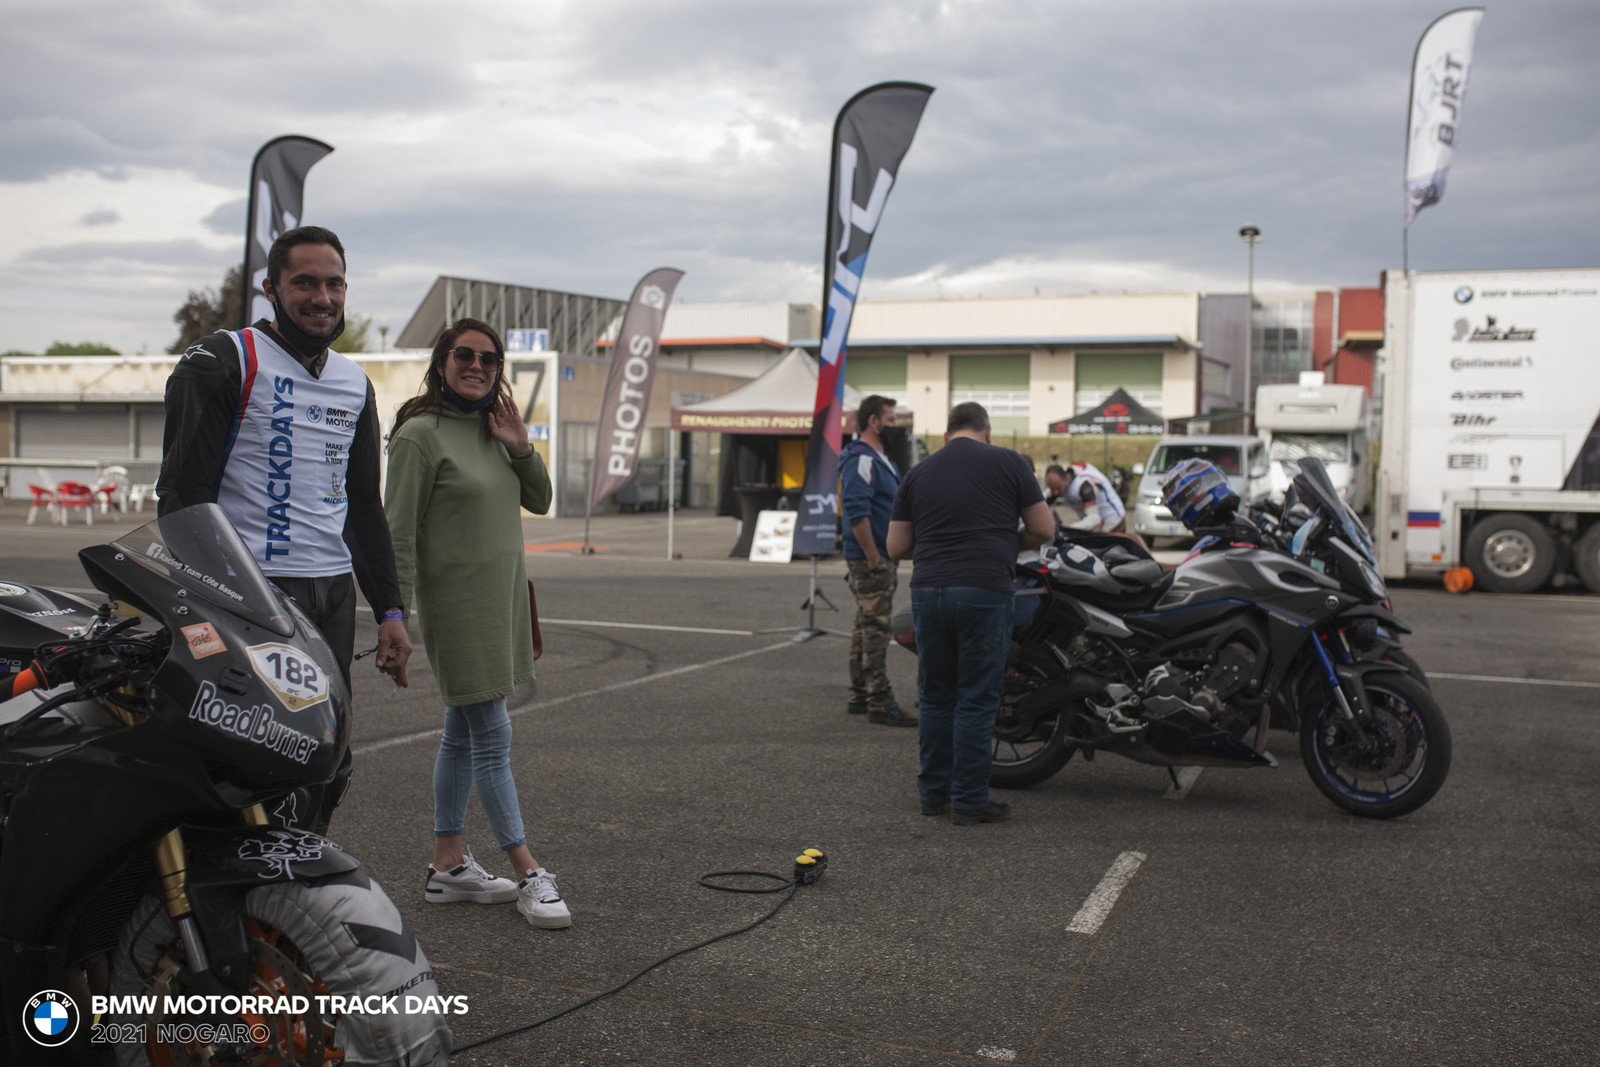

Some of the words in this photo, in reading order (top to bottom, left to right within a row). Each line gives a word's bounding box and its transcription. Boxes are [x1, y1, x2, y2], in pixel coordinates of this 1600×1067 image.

[1437, 53, 1463, 147] BJRT
[326, 407, 348, 418] BMW
[511, 361, 546, 424] 7
[608, 333, 654, 477] PHOTOS
[265, 375, 294, 561] TRACKDAYS
[325, 442, 343, 451] MAKE
[325, 449, 337, 457] LIFE
[159, 553, 183, 570] Racing
[182, 564, 202, 579] Team
[202, 574, 219, 588] Côte
[218, 583, 244, 602] Basque
[266, 652, 318, 694] 182
[189, 680, 319, 764] RoadBurner
